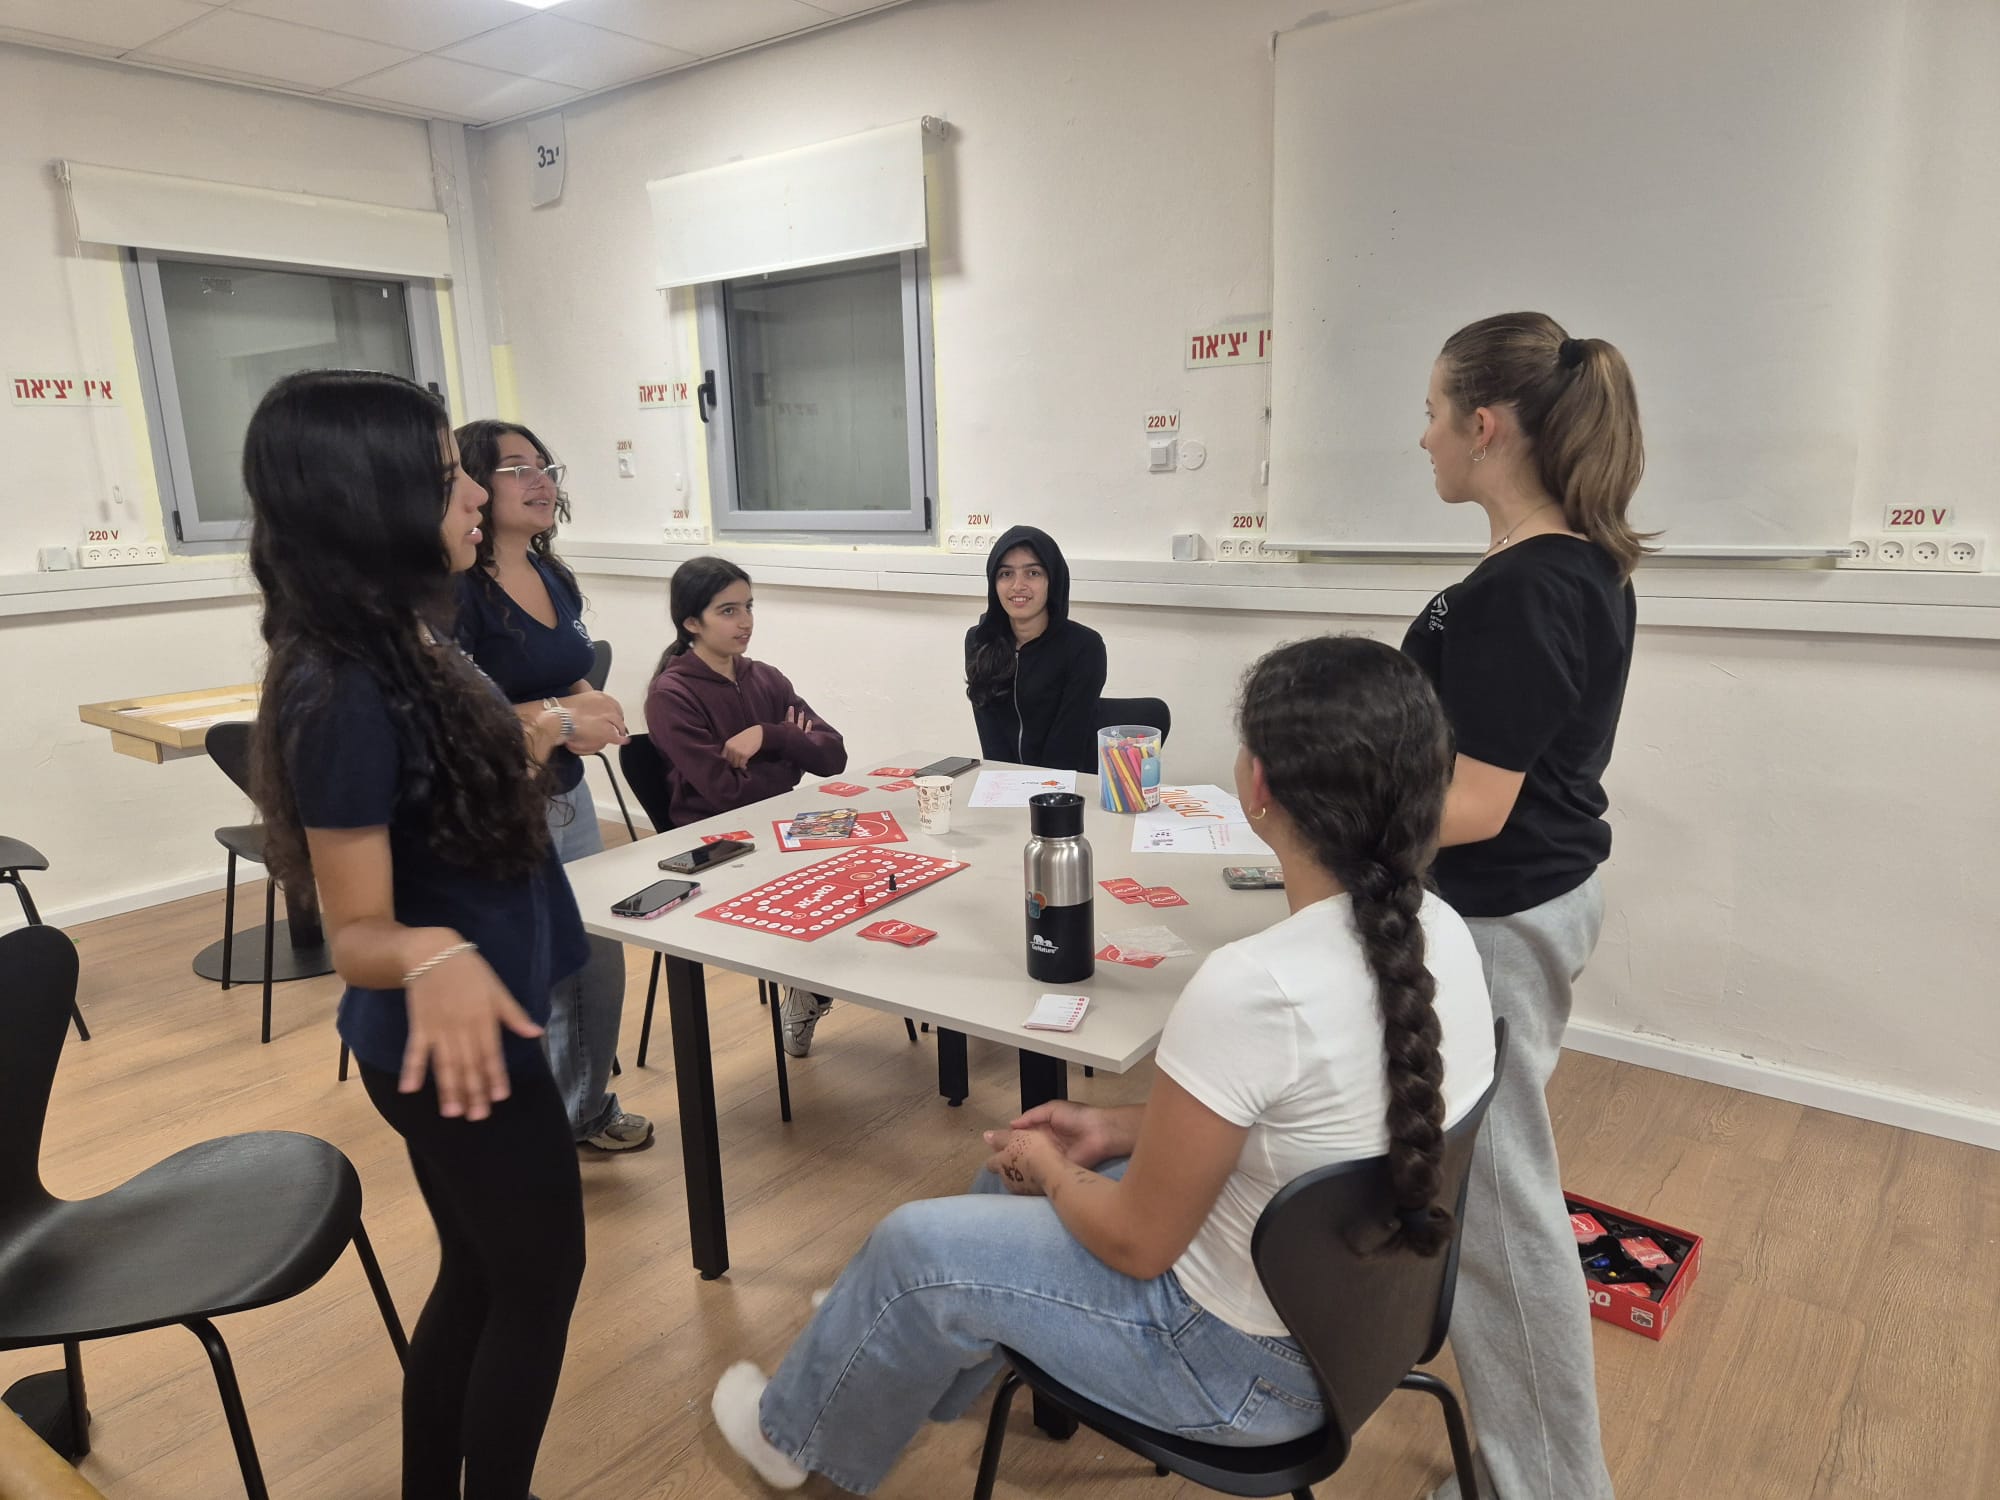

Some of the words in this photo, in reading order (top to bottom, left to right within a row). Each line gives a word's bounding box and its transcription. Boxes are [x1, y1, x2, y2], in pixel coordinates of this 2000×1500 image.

[1191, 331, 1248, 360] יציאה
[1259, 329, 1272, 358] ין
[14, 378, 73, 399] יציאה
[639, 384, 667, 402] יציאה
[1147, 415, 1167, 429] 220
[1169, 414, 1178, 427] V
[968, 514, 982, 525] 220
[983, 514, 990, 525] V
[1232, 515, 1253, 529] 220
[1255, 515, 1265, 529] V
[1890, 508, 1925, 526] 220
[1931, 508, 1946, 525] V
[88, 530, 108, 541] 220
[110, 529, 119, 540] V
